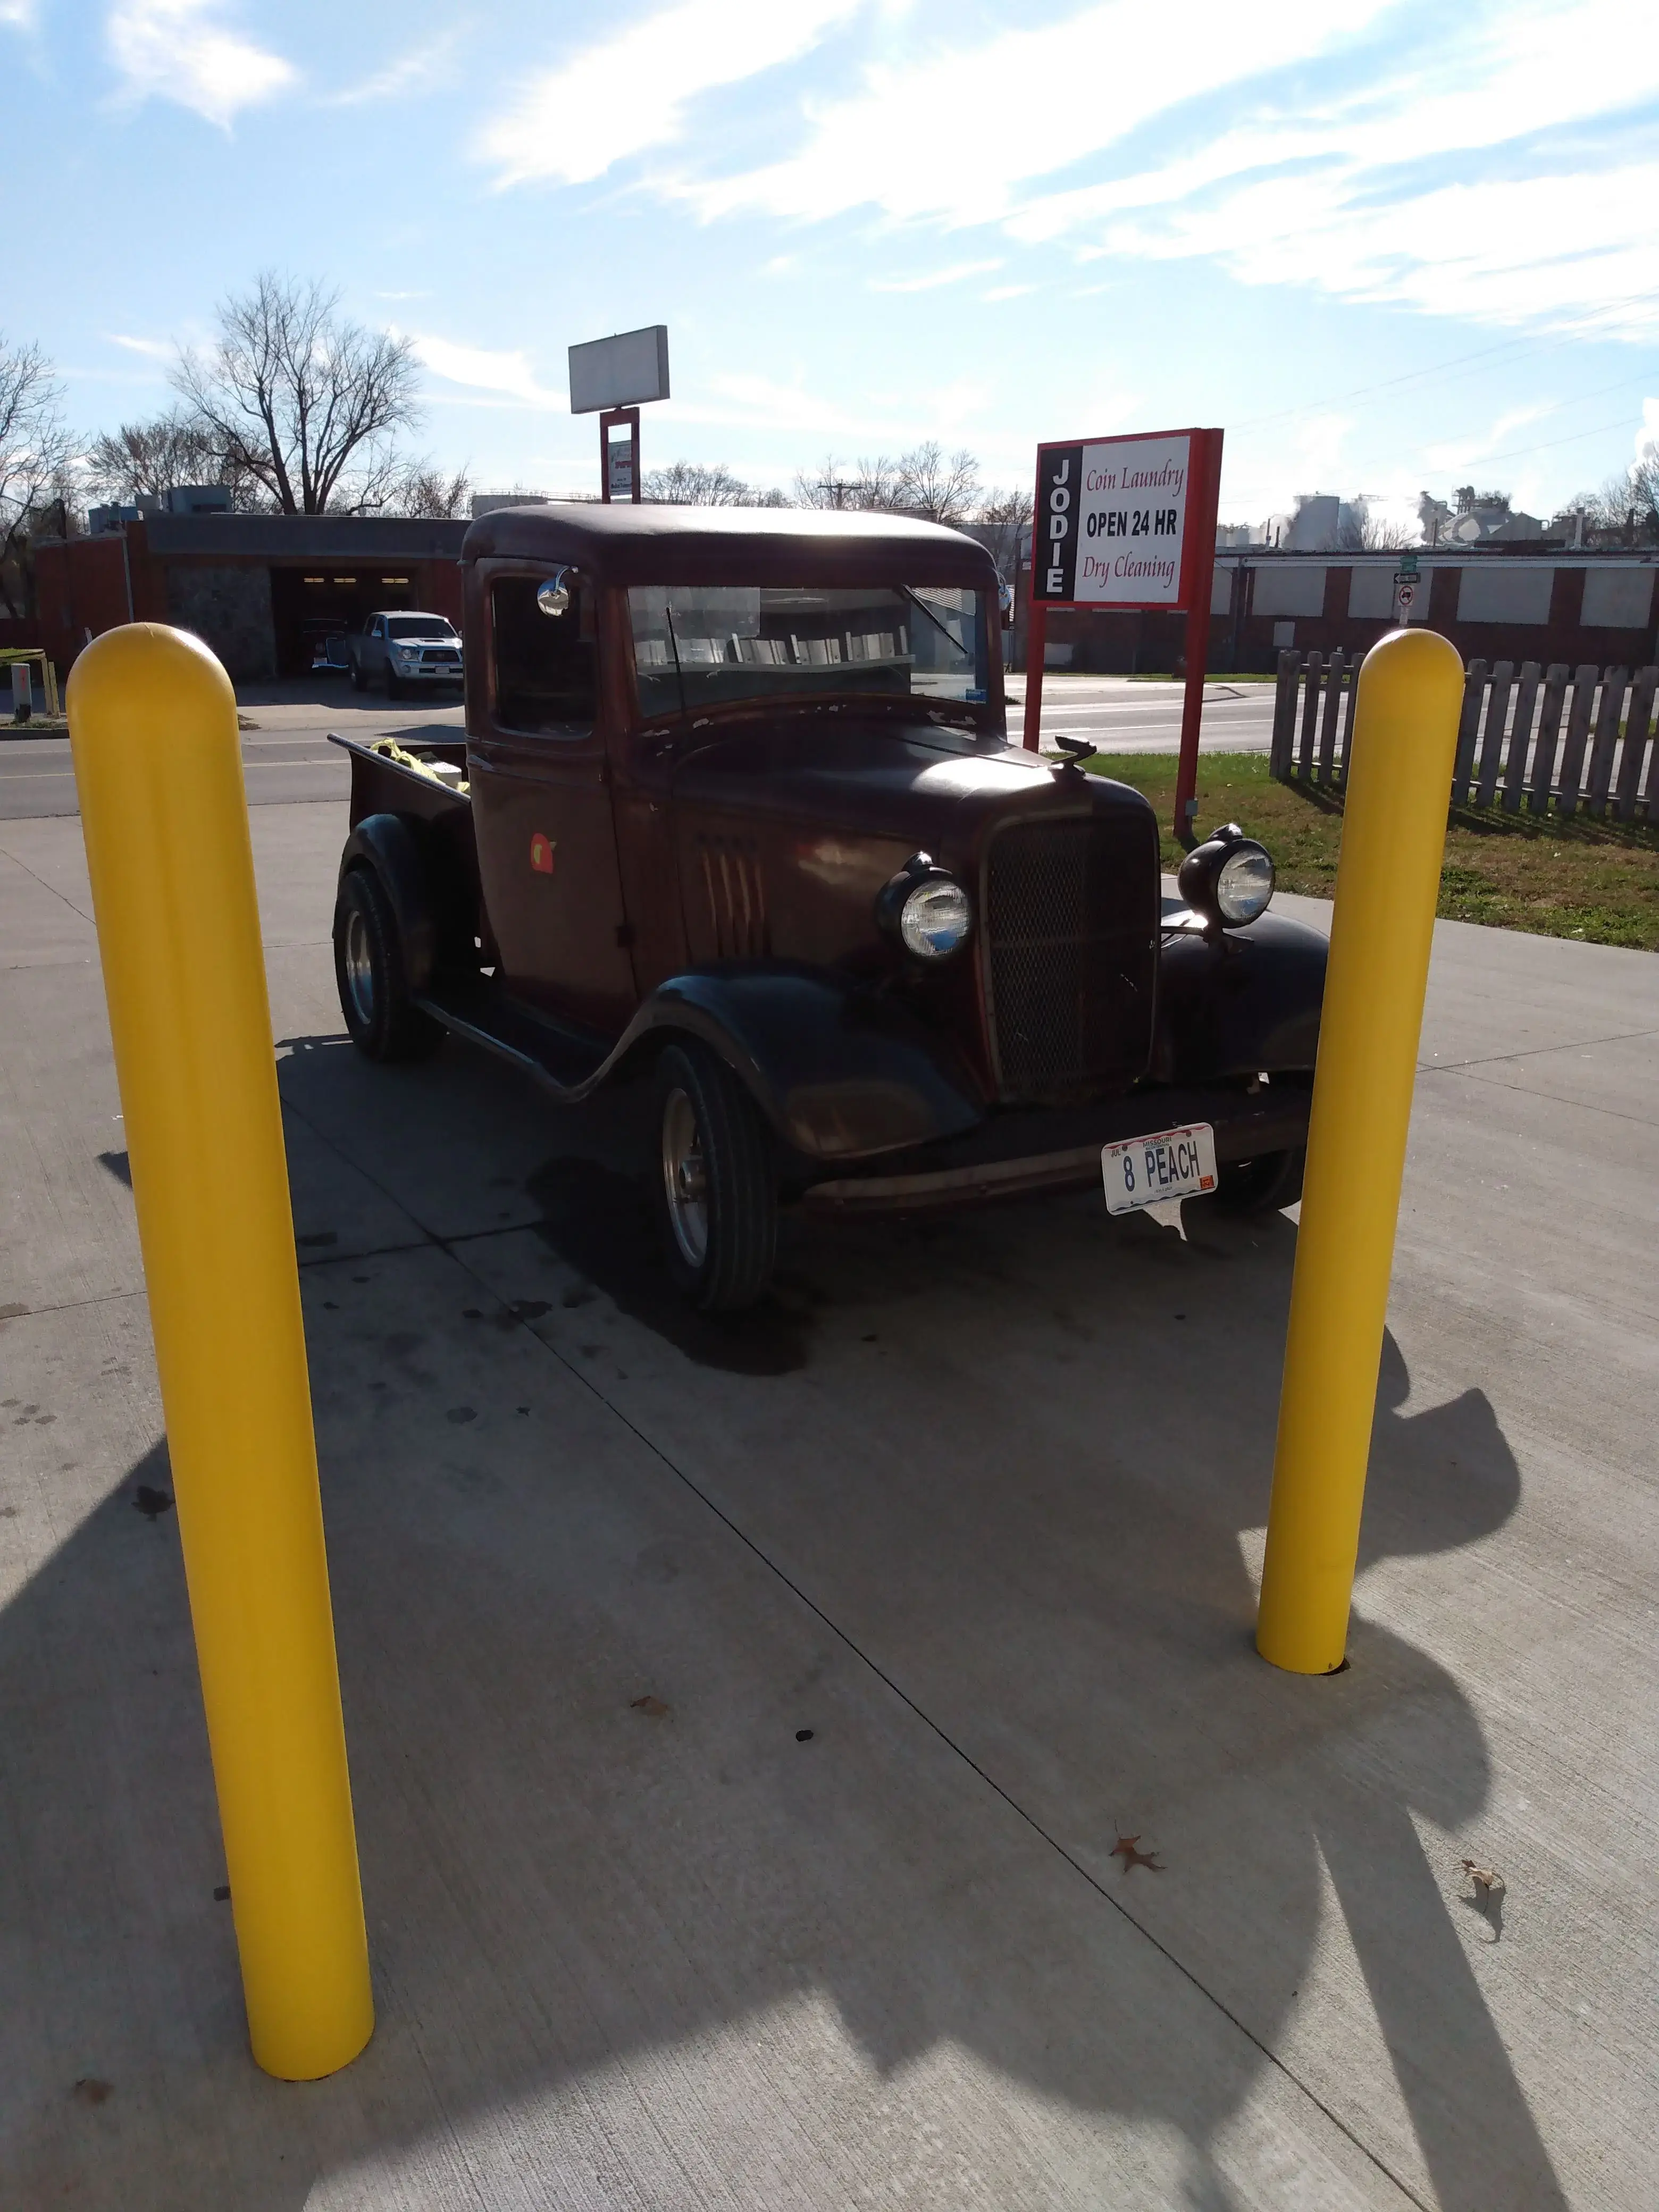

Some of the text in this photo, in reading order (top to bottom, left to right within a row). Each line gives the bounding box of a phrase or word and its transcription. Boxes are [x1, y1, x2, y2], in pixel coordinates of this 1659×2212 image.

[1086, 458, 1184, 497] Coin Laundry
[1046, 459, 1070, 593] JODIE
[1087, 509, 1177, 538] OPEN 24 HR
[1082, 551, 1176, 588] Dry Cleaning
[1111, 1149, 1121, 1158] JUL
[1143, 1136, 1172, 1148] MISSOURI
[1124, 1141, 1200, 1192] 8 PEACH
